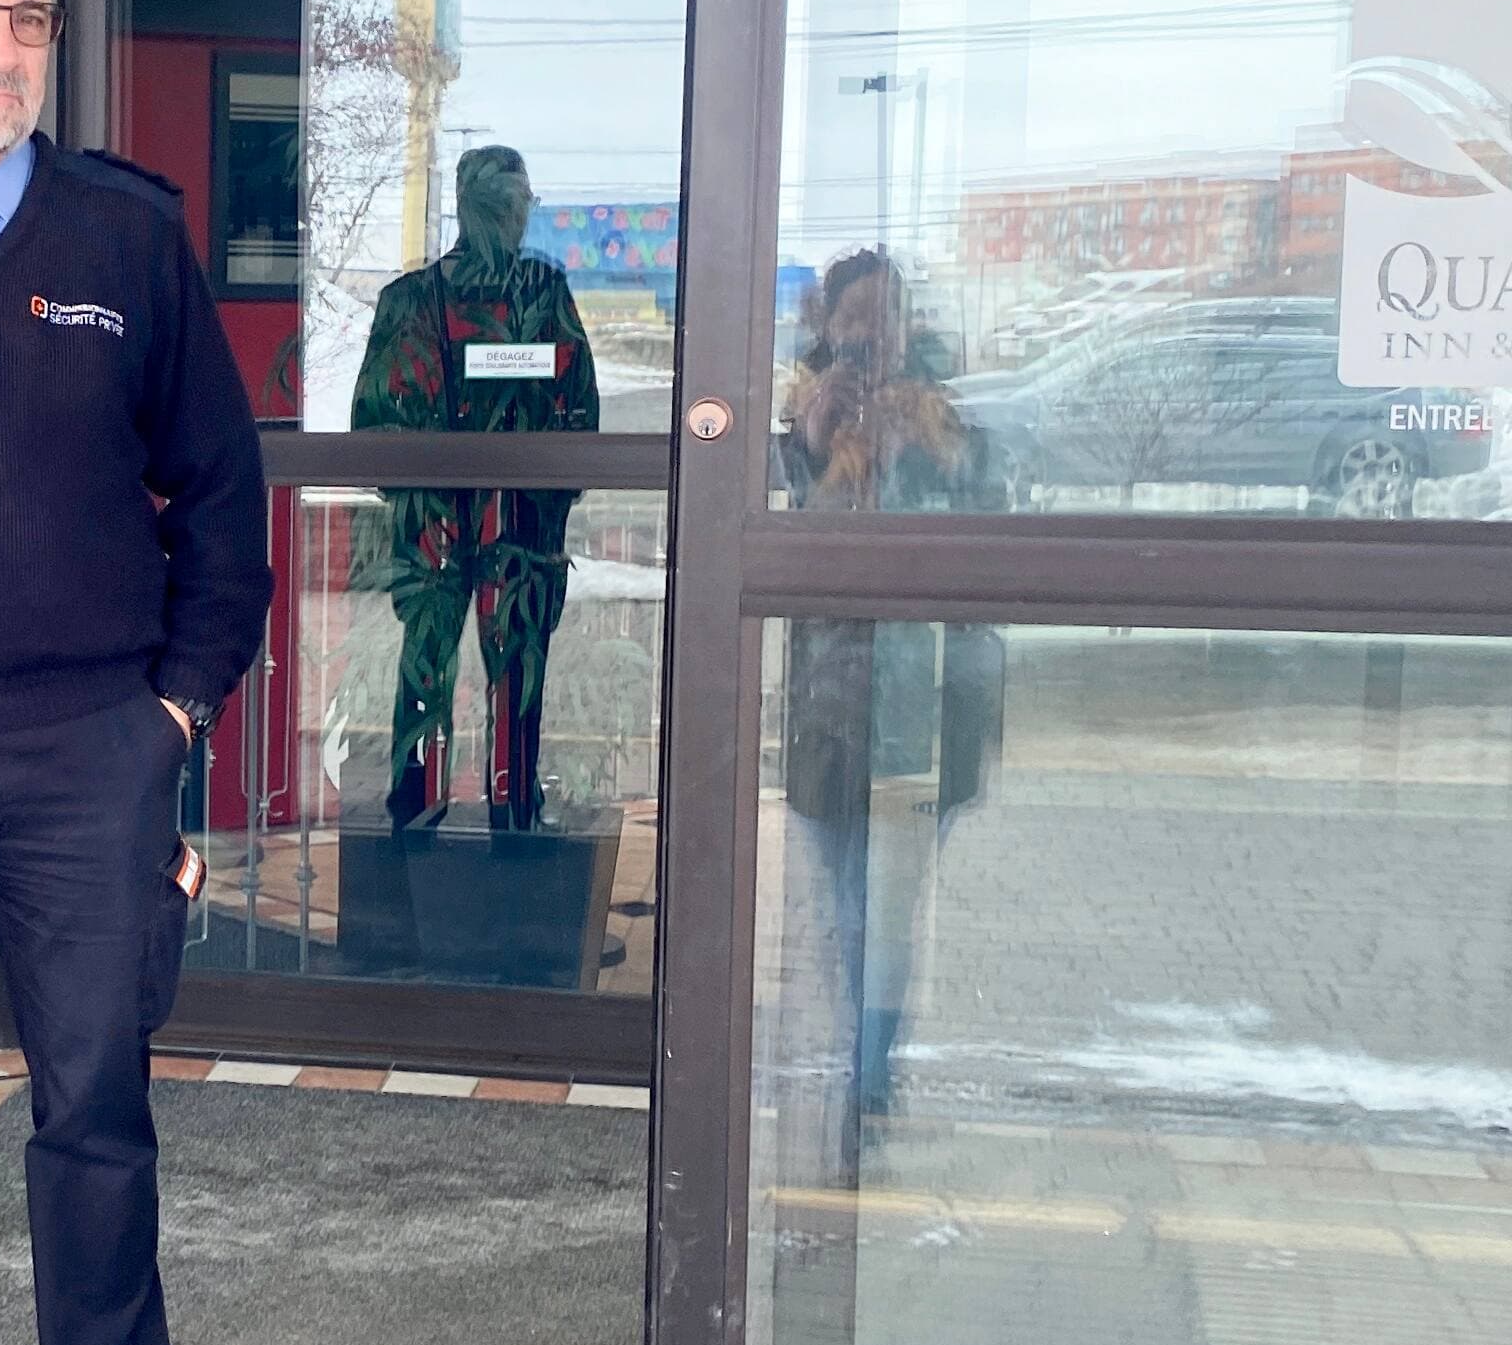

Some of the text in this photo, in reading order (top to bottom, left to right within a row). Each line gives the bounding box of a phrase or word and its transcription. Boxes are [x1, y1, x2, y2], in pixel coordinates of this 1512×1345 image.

[49, 311, 96, 325] SÉCURITÉ
[1381, 332, 1472, 360] INN
[486, 350, 534, 361] DÉGAGEZ
